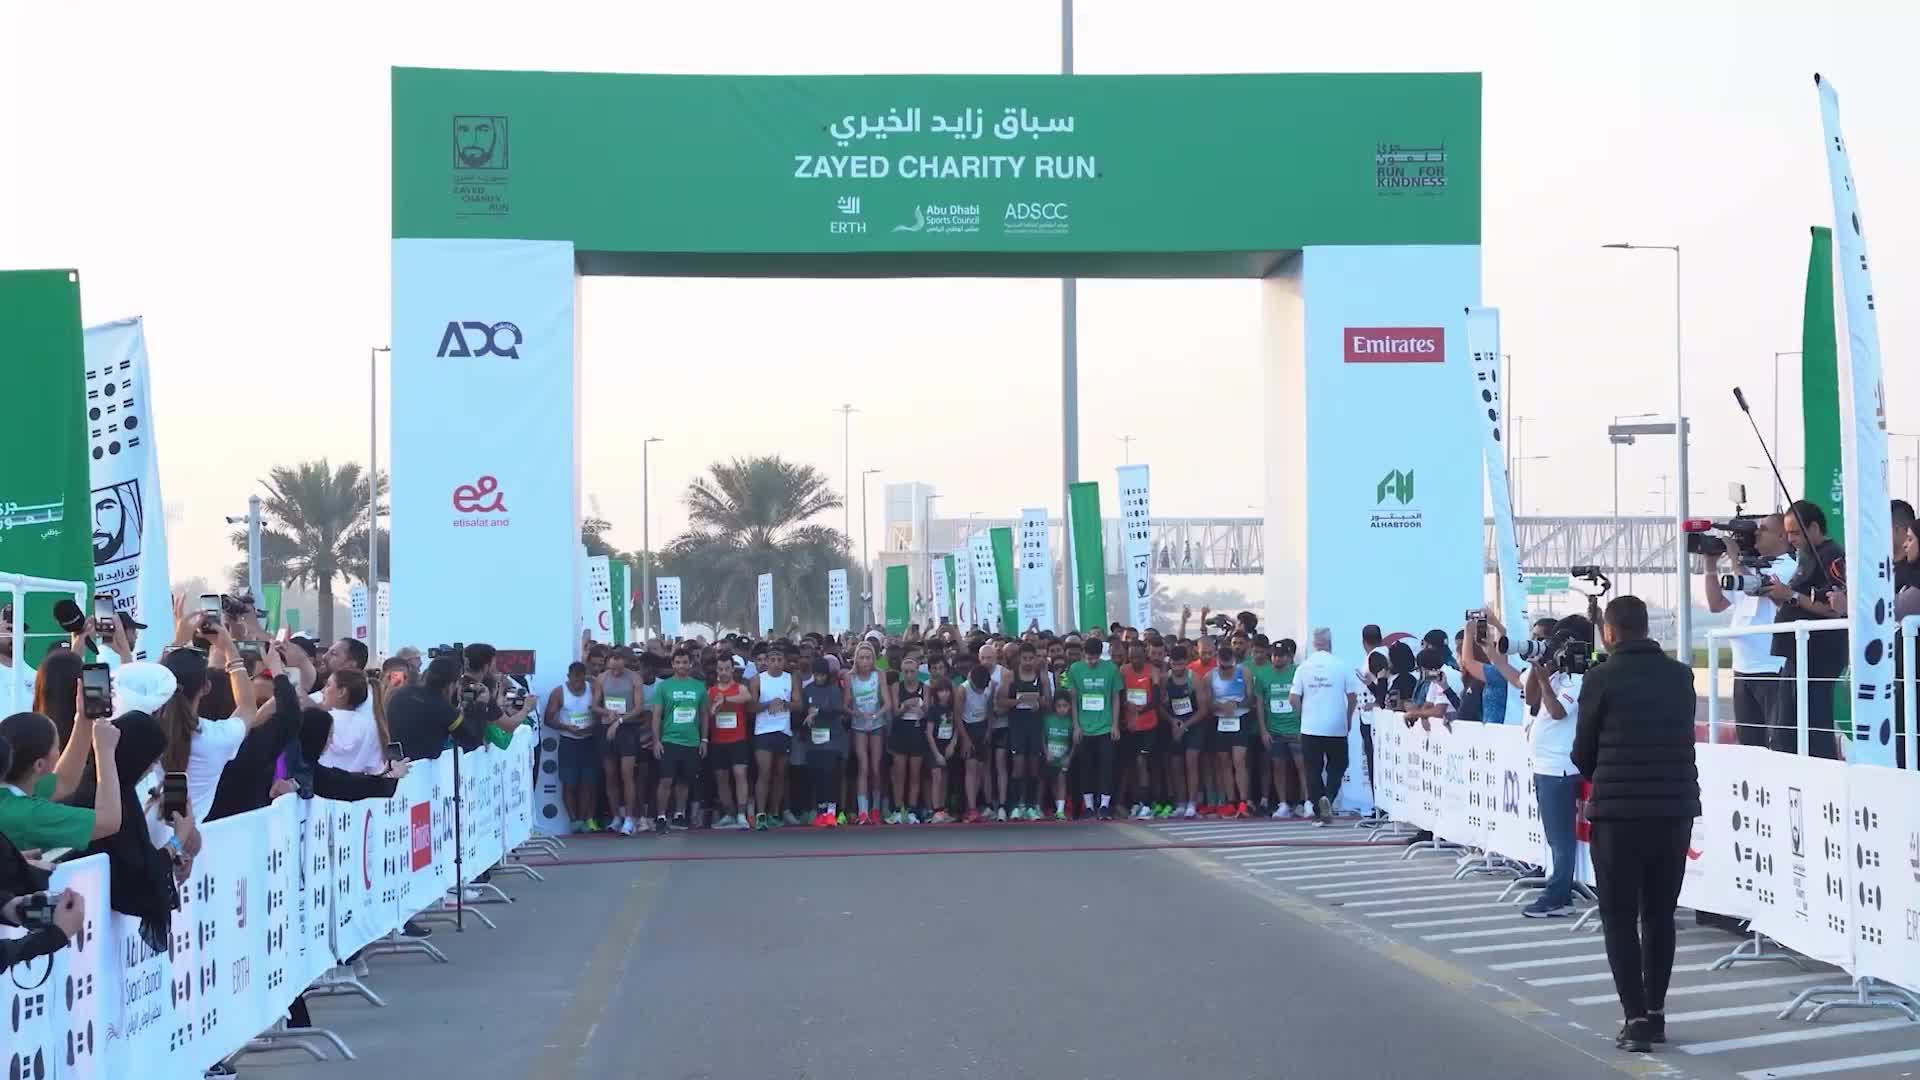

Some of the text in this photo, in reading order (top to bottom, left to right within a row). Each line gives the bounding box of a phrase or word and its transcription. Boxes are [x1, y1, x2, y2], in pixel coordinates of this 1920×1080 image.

[829, 107, 1075, 147] سباق زايد الخيري
[794, 155, 1096, 179] ZAYED CHARITY RUN
[1377, 167, 1445, 177] RUN FOR
[1377, 176, 1446, 188] KINDNESS
[926, 205, 980, 215] Abu Dhabi
[1004, 202, 1069, 220] ADSCC
[830, 221, 866, 233] ERTH
[926, 215, 980, 226] Sports Council
[436, 321, 523, 360] ADQ
[1353, 335, 1436, 354] Emirates
[453, 518, 510, 528] etisalat and
[1369, 521, 1422, 529] ALHABTOOR
[1906, 907, 1920, 942] ER
[232, 954, 250, 995] ERTH
